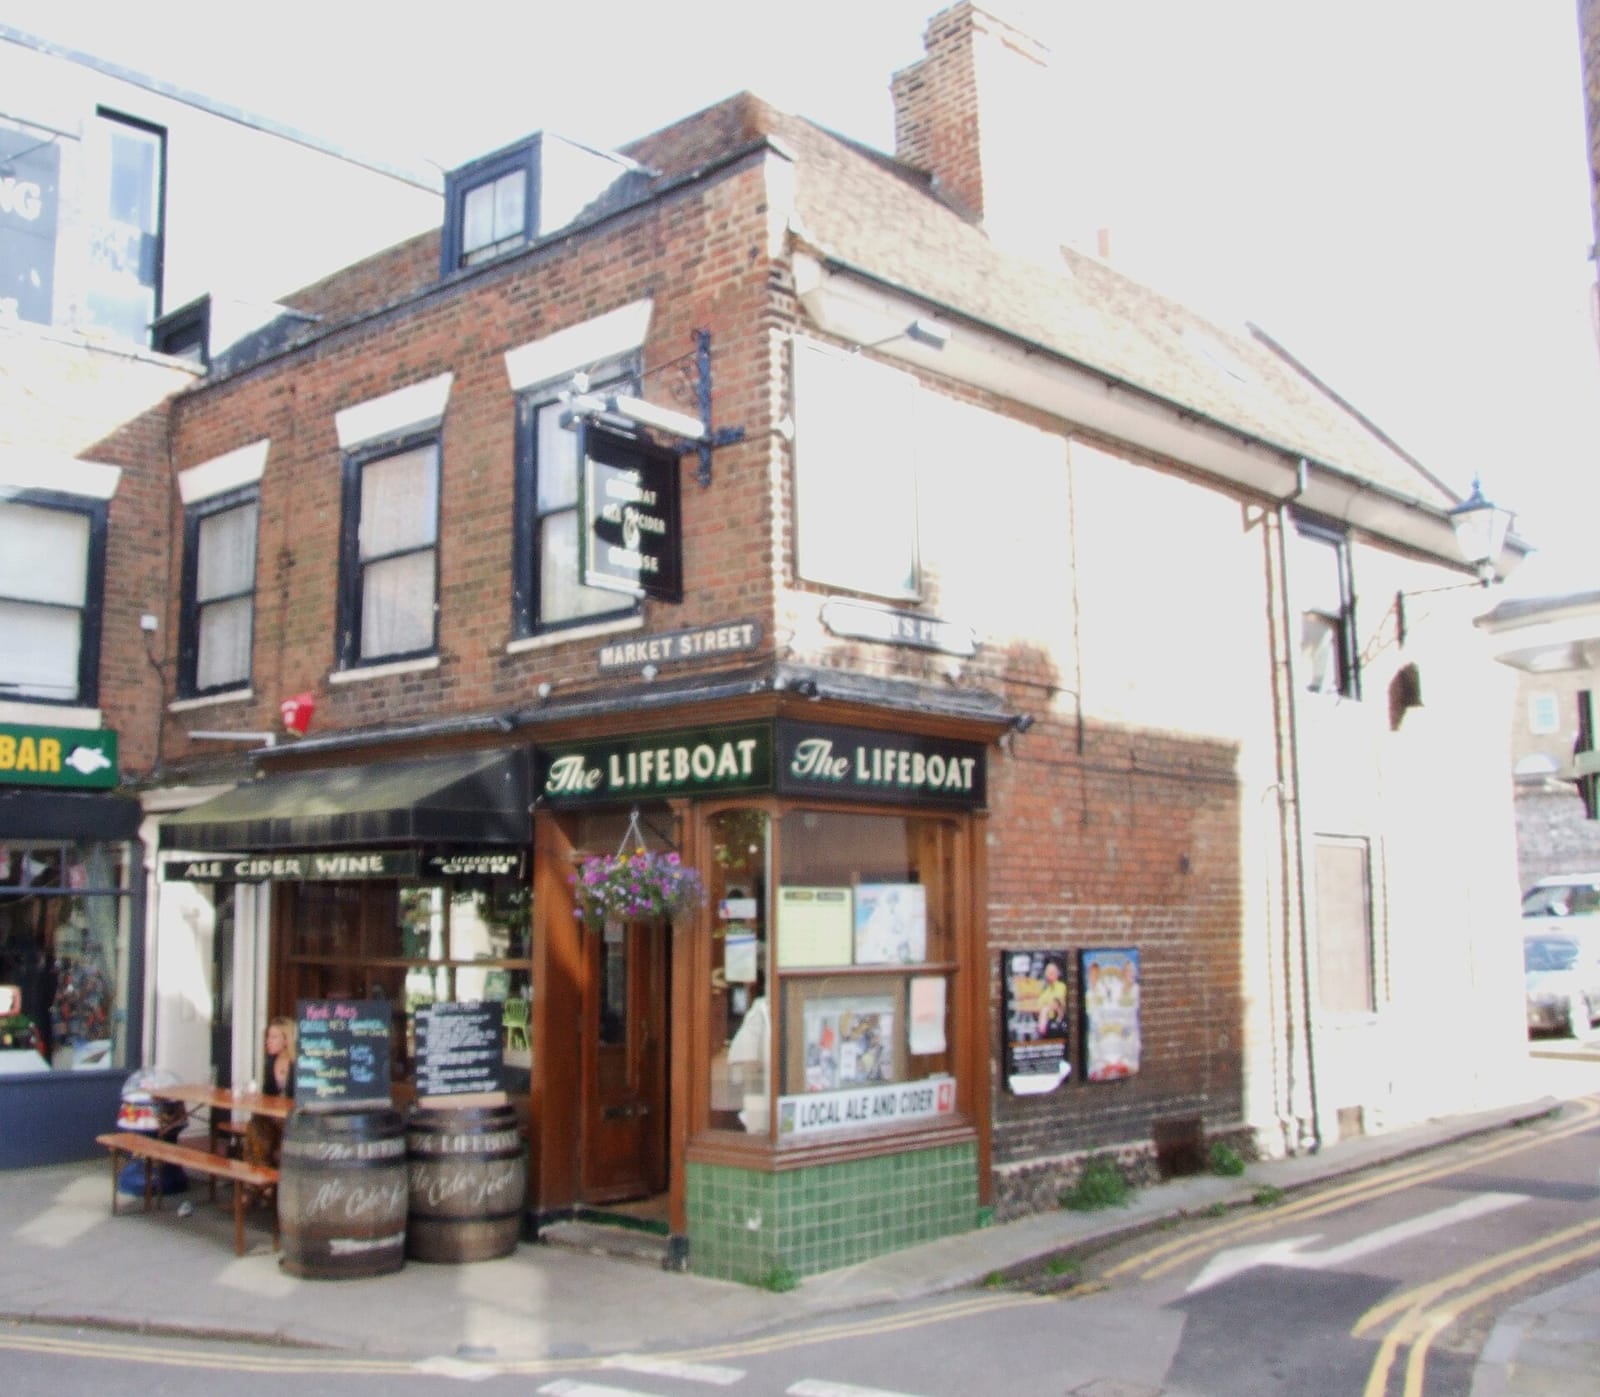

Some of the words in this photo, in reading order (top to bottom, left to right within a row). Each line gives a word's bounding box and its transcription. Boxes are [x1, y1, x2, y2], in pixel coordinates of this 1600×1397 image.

[600, 640, 671, 666] MARKET
[679, 624, 755, 655] STREET
[0, 736, 61, 773] BAR
[545, 755, 602, 793] The
[608, 739, 757, 787] LIFEBOAT
[791, 738, 849, 777] The
[855, 746, 976, 791] LIFEBOAT
[185, 862, 223, 877] ALE
[234, 859, 301, 876] CIDER
[315, 855, 385, 874] WINE
[441, 863, 510, 875] OPEN
[800, 1098, 841, 1128] LOCAL
[845, 1095, 869, 1121] ALE
[871, 1092, 896, 1117] AND
[900, 1087, 935, 1114] CIDER
